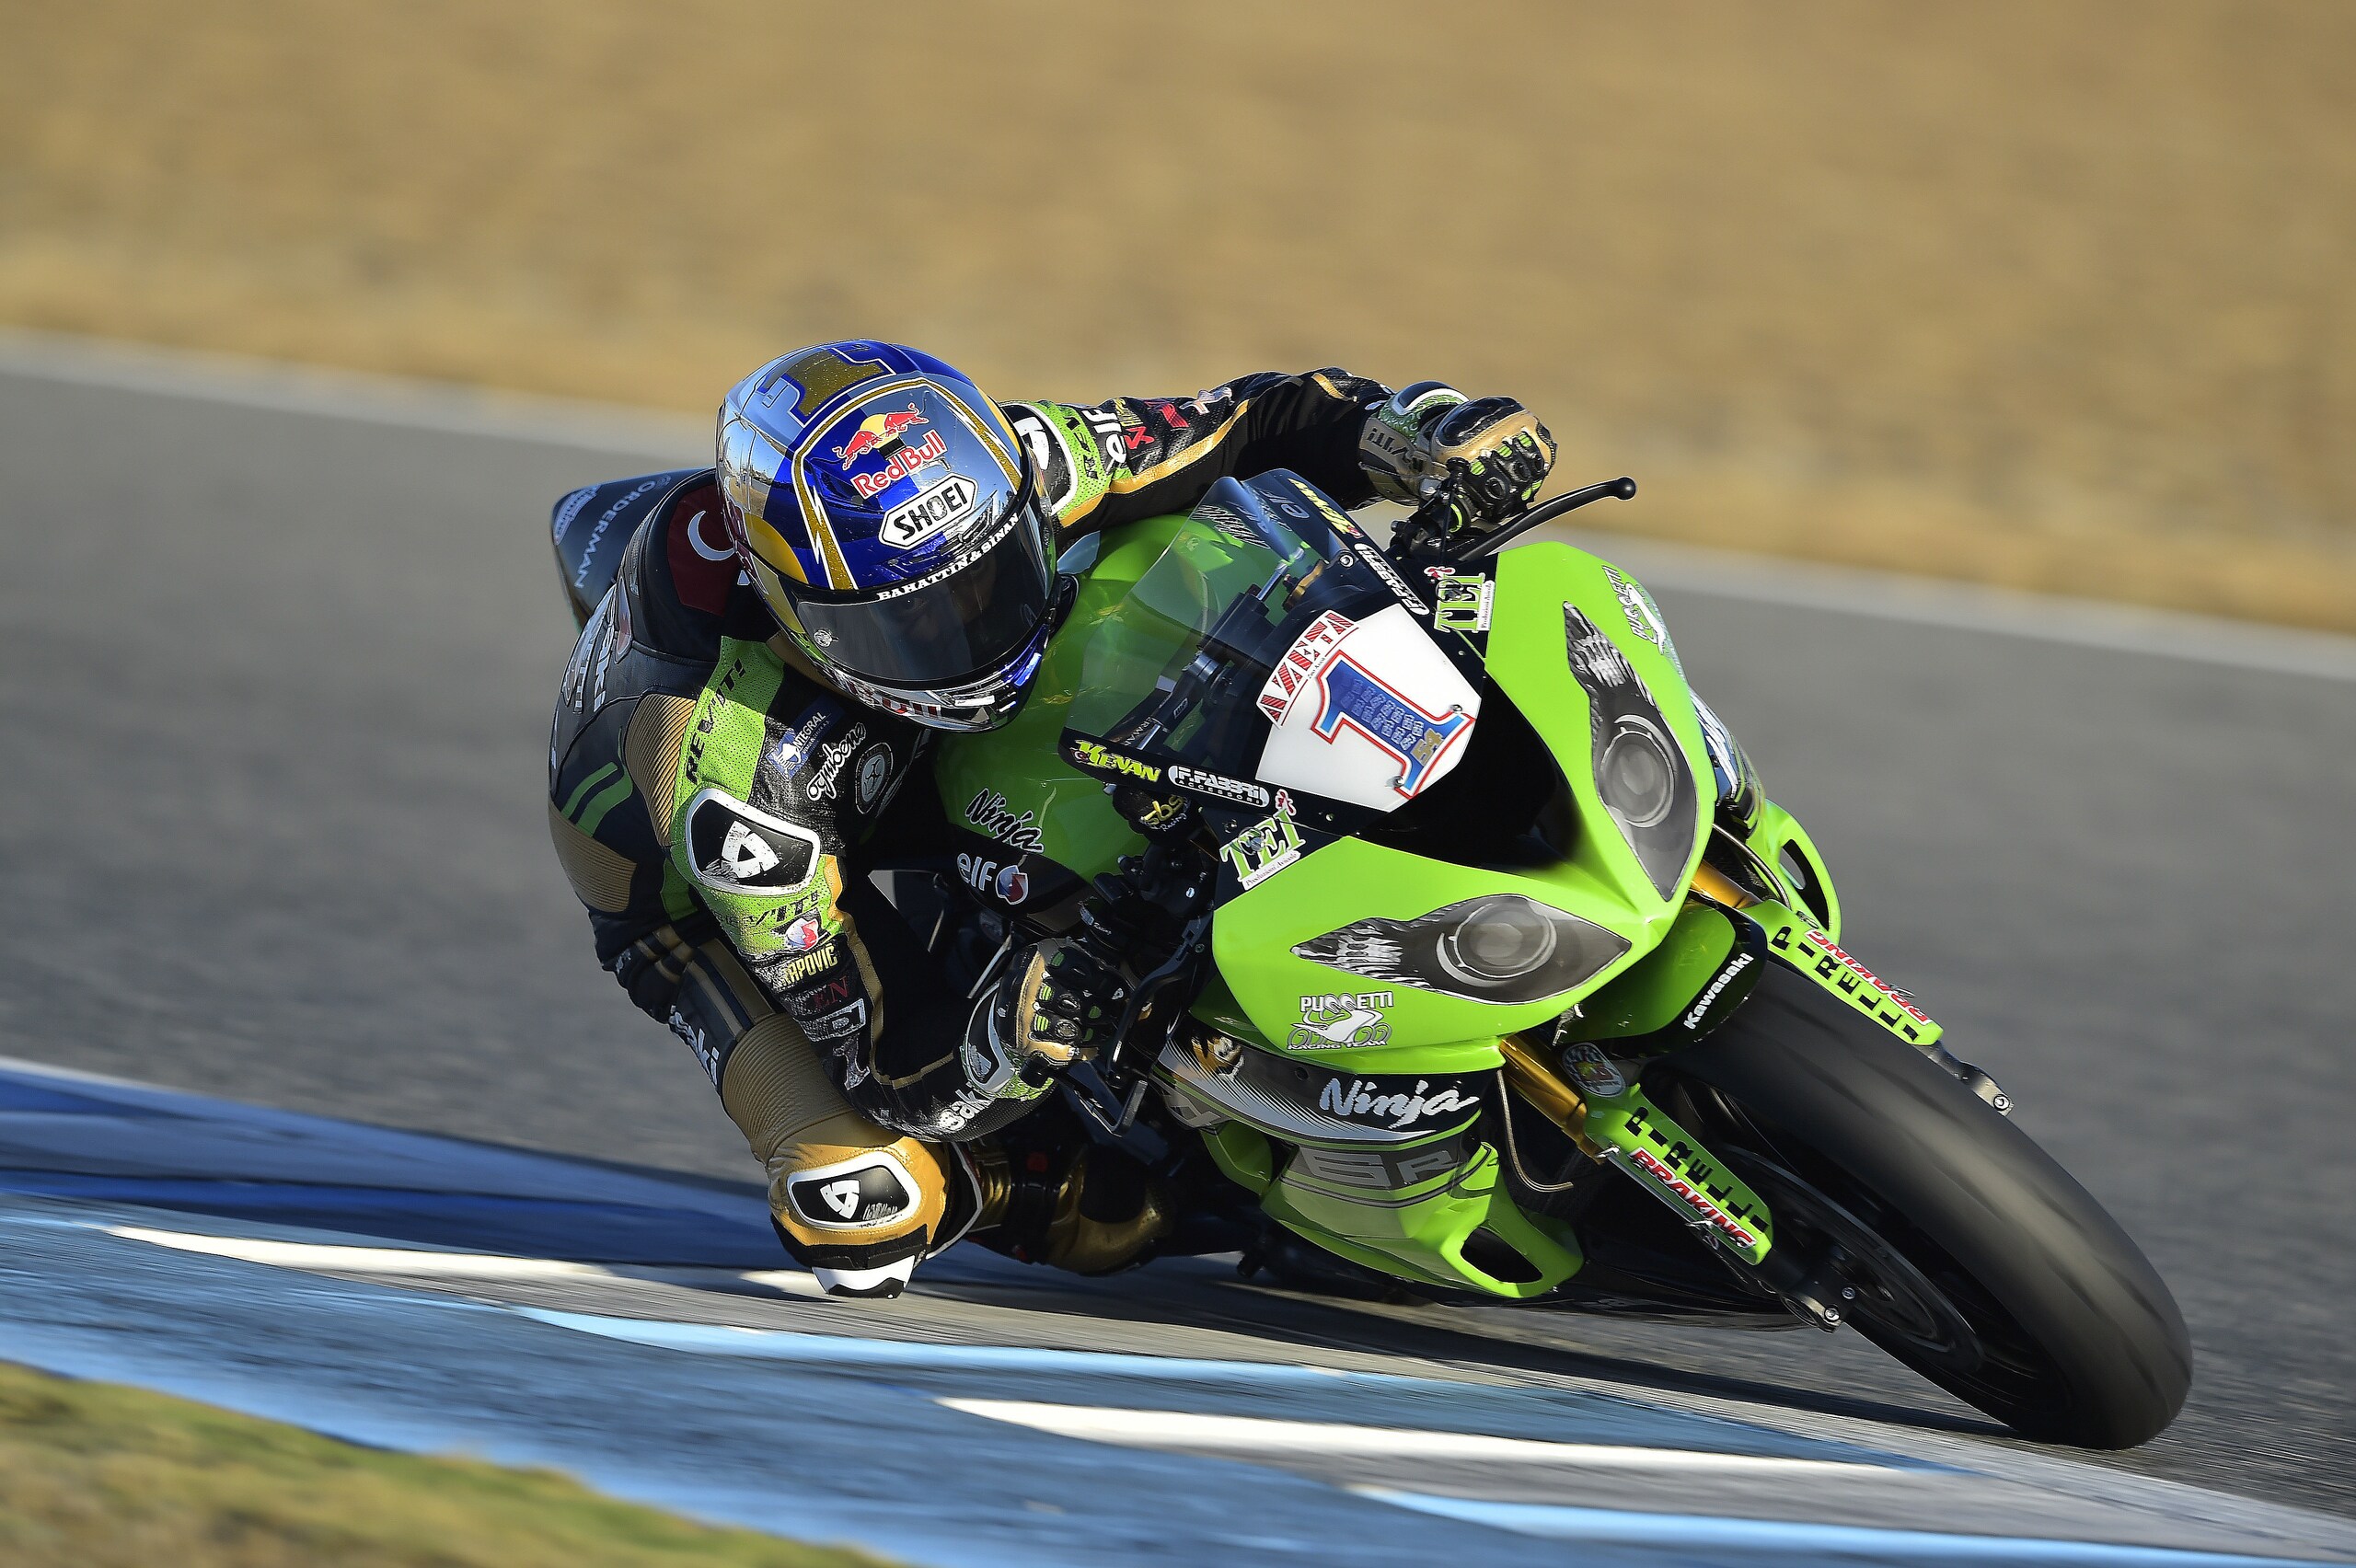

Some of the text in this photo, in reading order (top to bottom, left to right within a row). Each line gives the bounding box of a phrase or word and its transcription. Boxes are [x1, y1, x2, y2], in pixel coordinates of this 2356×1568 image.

[851, 430, 948, 500] Red Bull
[894, 483, 967, 541] SHOEI
[1260, 612, 1355, 722] AZETA
[1311, 650, 1476, 800] 1
[1075, 740, 1161, 782] KENAN
[1178, 767, 1259, 799] F.FABBRI
[1178, 779, 1261, 804] ACCESSORI
[964, 788, 1045, 853] Ninja
[957, 853, 998, 892] elf
[1683, 952, 1754, 1030] Kawasaki
[1771, 926, 1919, 1042] PIRELLI
[1806, 929, 1932, 1024] BRAKING
[1319, 1078, 1480, 1129] Ninja
[1624, 1106, 1769, 1233] PIRELLI
[1629, 1147, 1757, 1249] BRAKING
